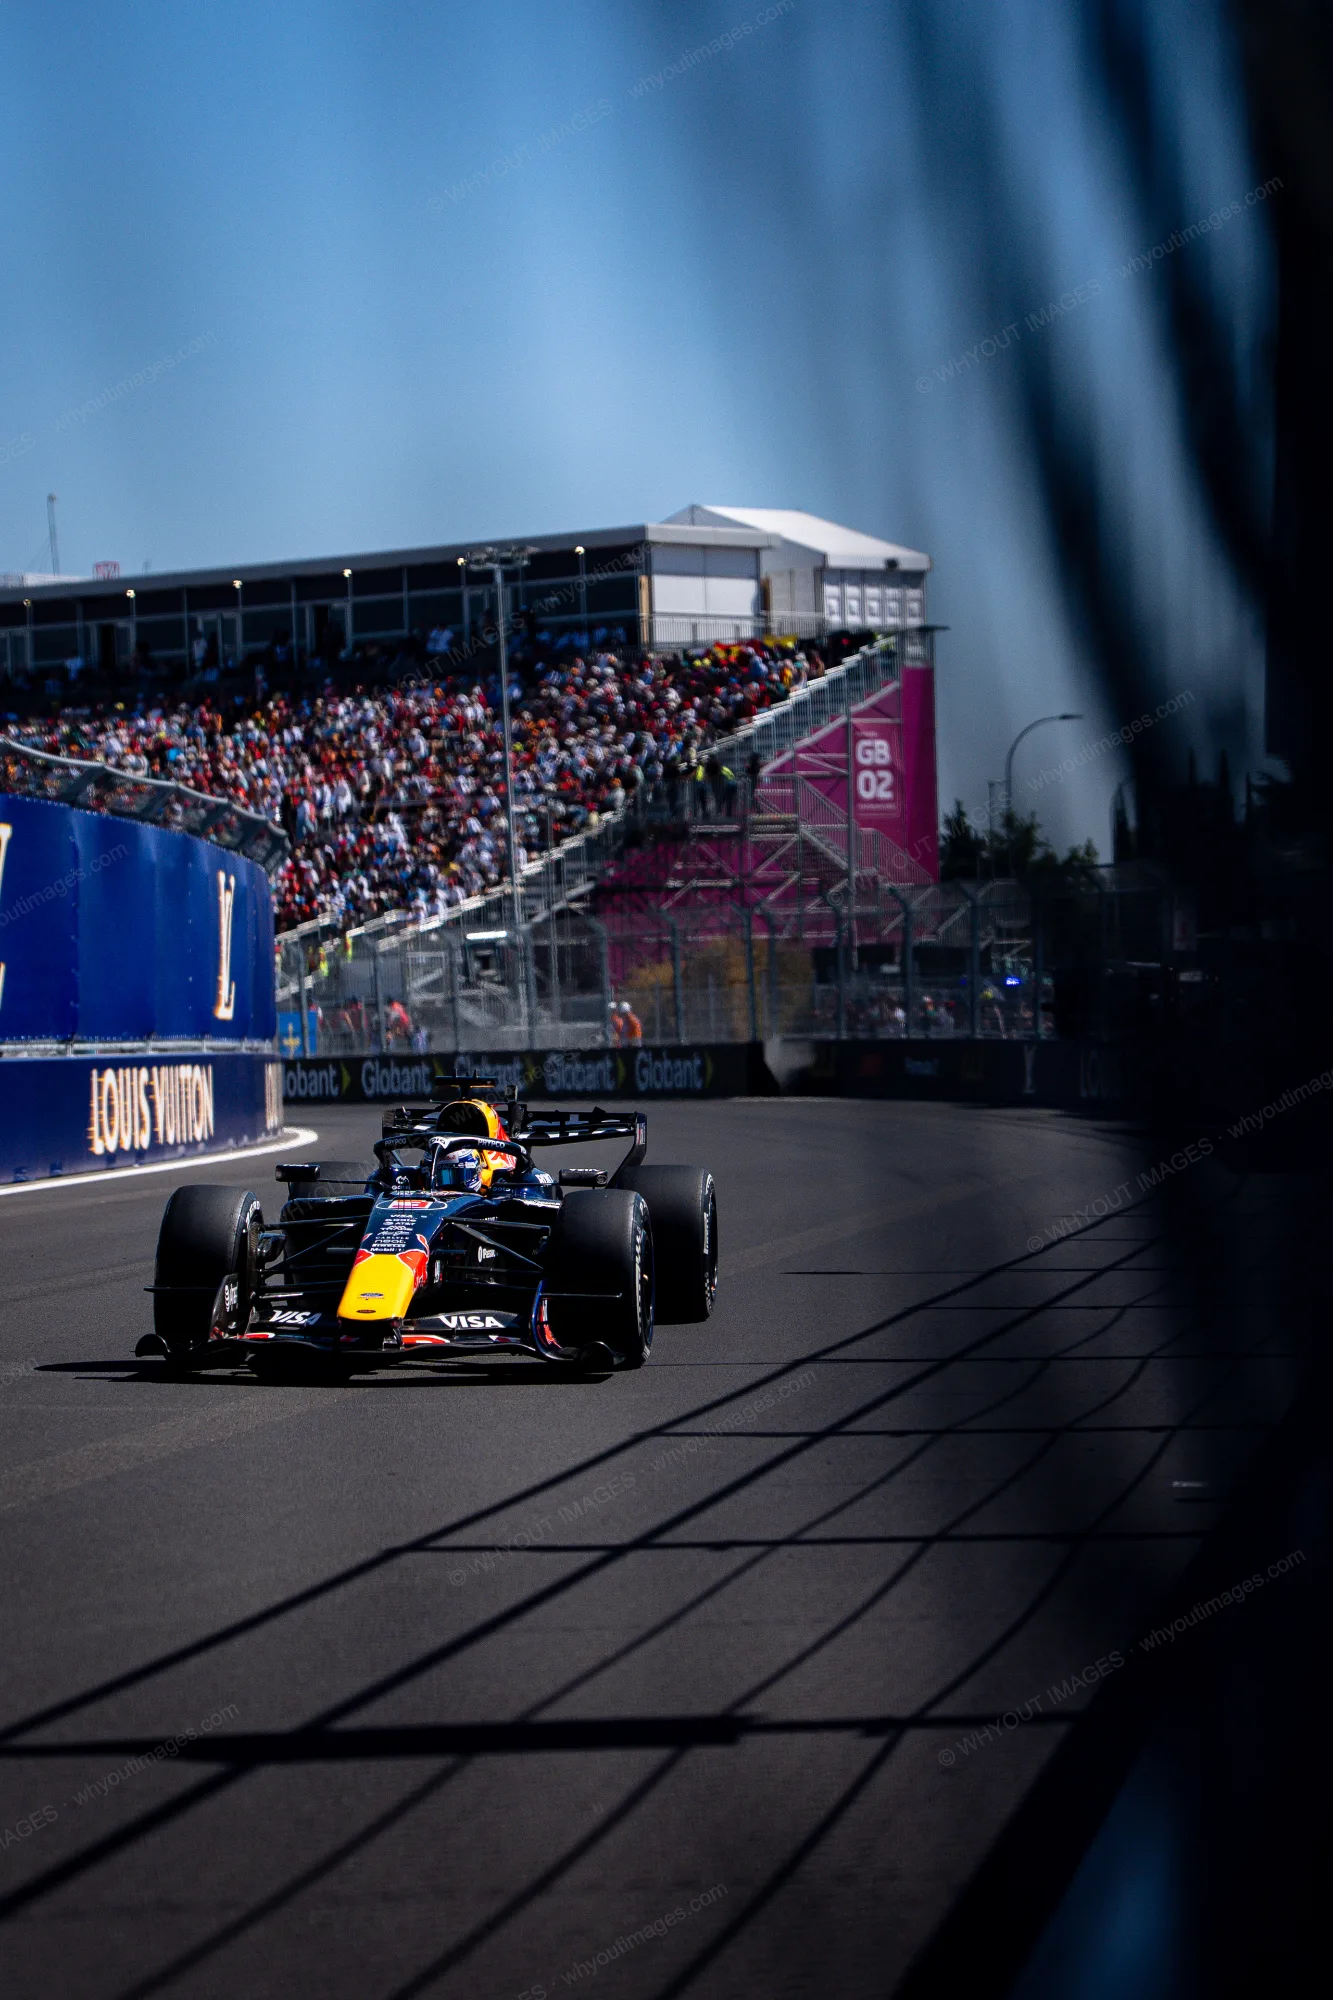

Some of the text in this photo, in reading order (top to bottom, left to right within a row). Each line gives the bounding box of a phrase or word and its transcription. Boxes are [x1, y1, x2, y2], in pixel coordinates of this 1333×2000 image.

[856, 738, 891, 766] GB
[857, 769, 894, 800] 02
[282, 1063, 339, 1097] lobant
[361, 1059, 432, 1097] Globant
[544, 1051, 616, 1092] Globant
[635, 1050, 703, 1091] Globant
[91, 1066, 151, 1155] LOUIS
[152, 1063, 214, 1145] VUITTON
[477, 1138, 506, 1149] PRYPCO
[269, 1309, 323, 1325] VISA
[439, 1315, 505, 1329] VISA
